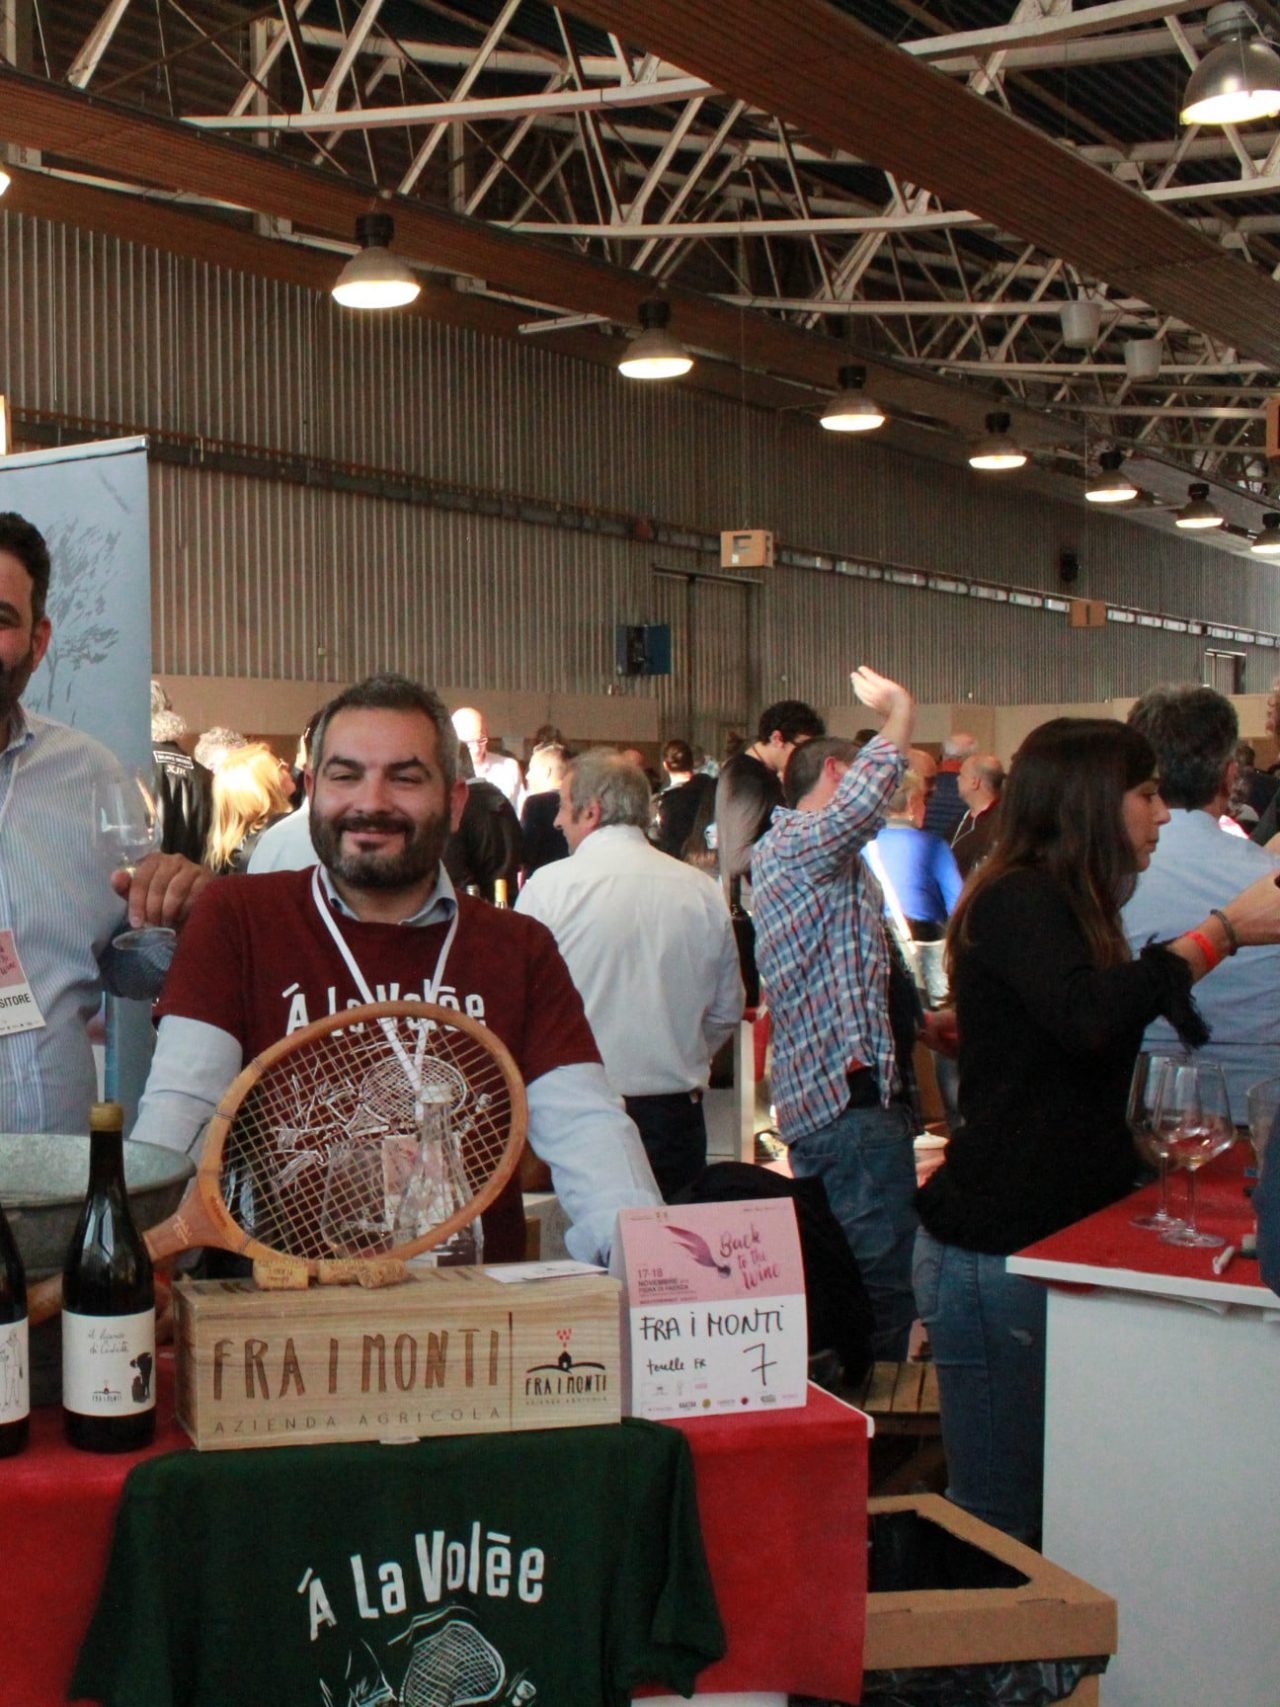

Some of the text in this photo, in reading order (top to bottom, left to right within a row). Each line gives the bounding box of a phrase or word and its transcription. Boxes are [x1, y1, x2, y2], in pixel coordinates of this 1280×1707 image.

[720, 1223, 761, 1258] Back
[744, 1266, 780, 1290] Wine
[640, 1316, 680, 1341] FRA
[213, 1328, 499, 1400] FRA I MONTI
[742, 1343, 778, 1386] 7
[525, 1374, 607, 1396] FRA I MONTI
[214, 1406, 501, 1434] AZIENDA AGRICOLA
[350, 1554, 407, 1618] La
